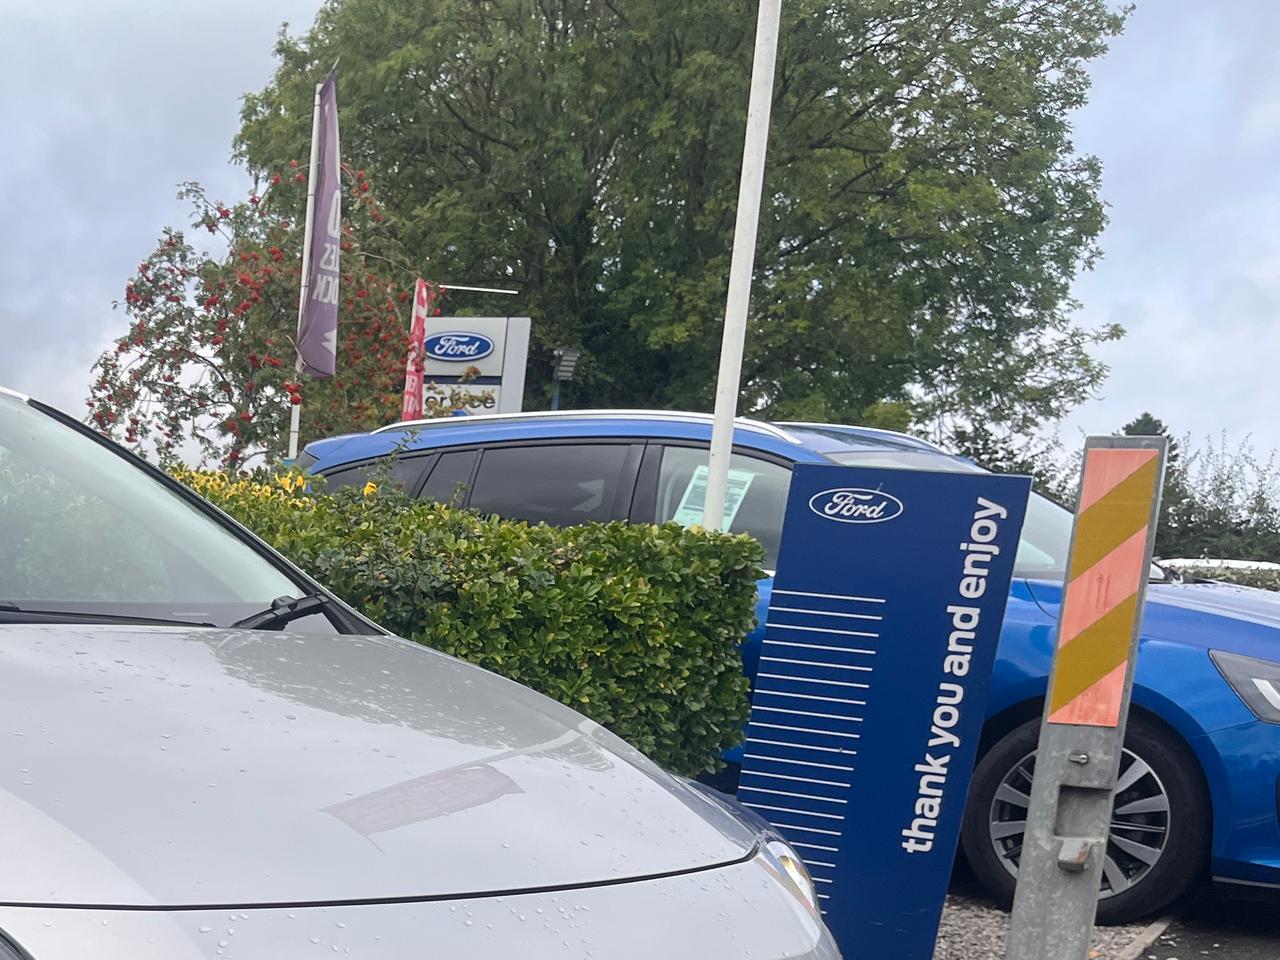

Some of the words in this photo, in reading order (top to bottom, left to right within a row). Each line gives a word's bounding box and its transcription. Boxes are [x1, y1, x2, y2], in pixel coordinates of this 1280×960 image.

[434, 335, 480, 355] Ford
[824, 491, 888, 519] Ford
[959, 496, 1008, 599] enjoy
[943, 605, 981, 677] and
[928, 682, 964, 747] you
[902, 753, 951, 853] thank
